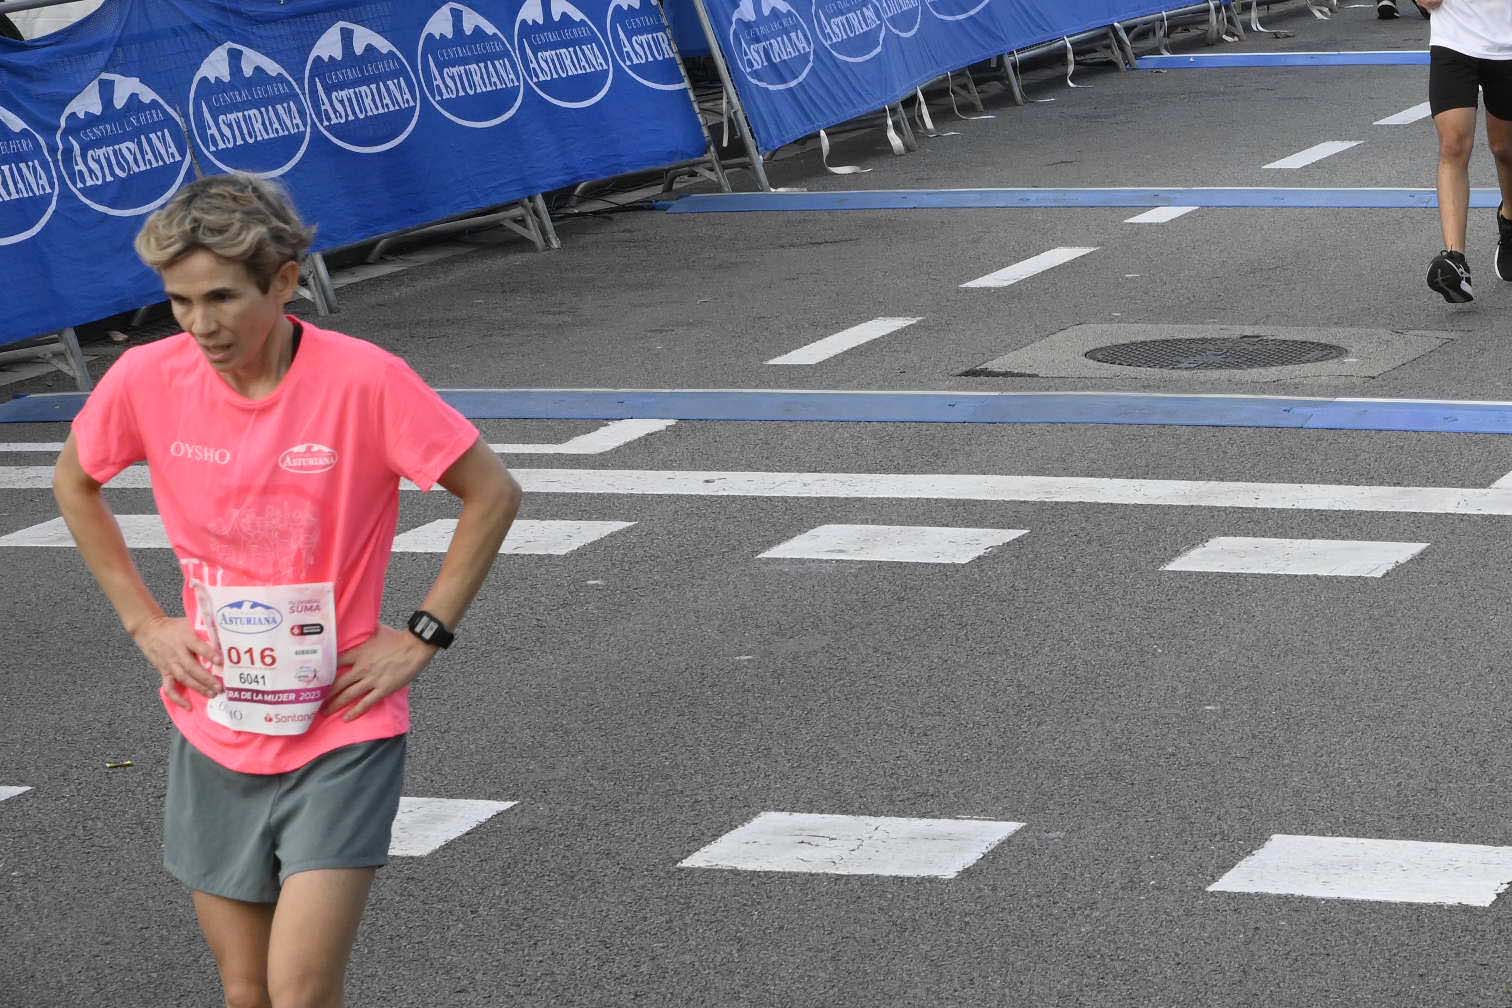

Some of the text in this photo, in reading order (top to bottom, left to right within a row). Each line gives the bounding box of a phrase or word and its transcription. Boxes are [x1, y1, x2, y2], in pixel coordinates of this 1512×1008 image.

[531, 26, 592, 46] CENTRAL LECHERA
[616, 22, 677, 66] ASTUR
[436, 41, 504, 61] CENTRAL LECHERA
[523, 37, 609, 84] ASTURIANA
[326, 58, 400, 84] CENTRAL LECHERA
[428, 53, 520, 103] ASTURIANA
[212, 83, 289, 107] CENTRAL LECHERA
[315, 76, 416, 128] ASTURIANA
[201, 99, 305, 153] ASTURIANA
[170, 440, 231, 465] OYSHO
[219, 614, 277, 625] ASTURIANA
[228, 646, 277, 666] 016
[239, 672, 266, 686] 6041
[264, 693, 296, 701] MUJER
